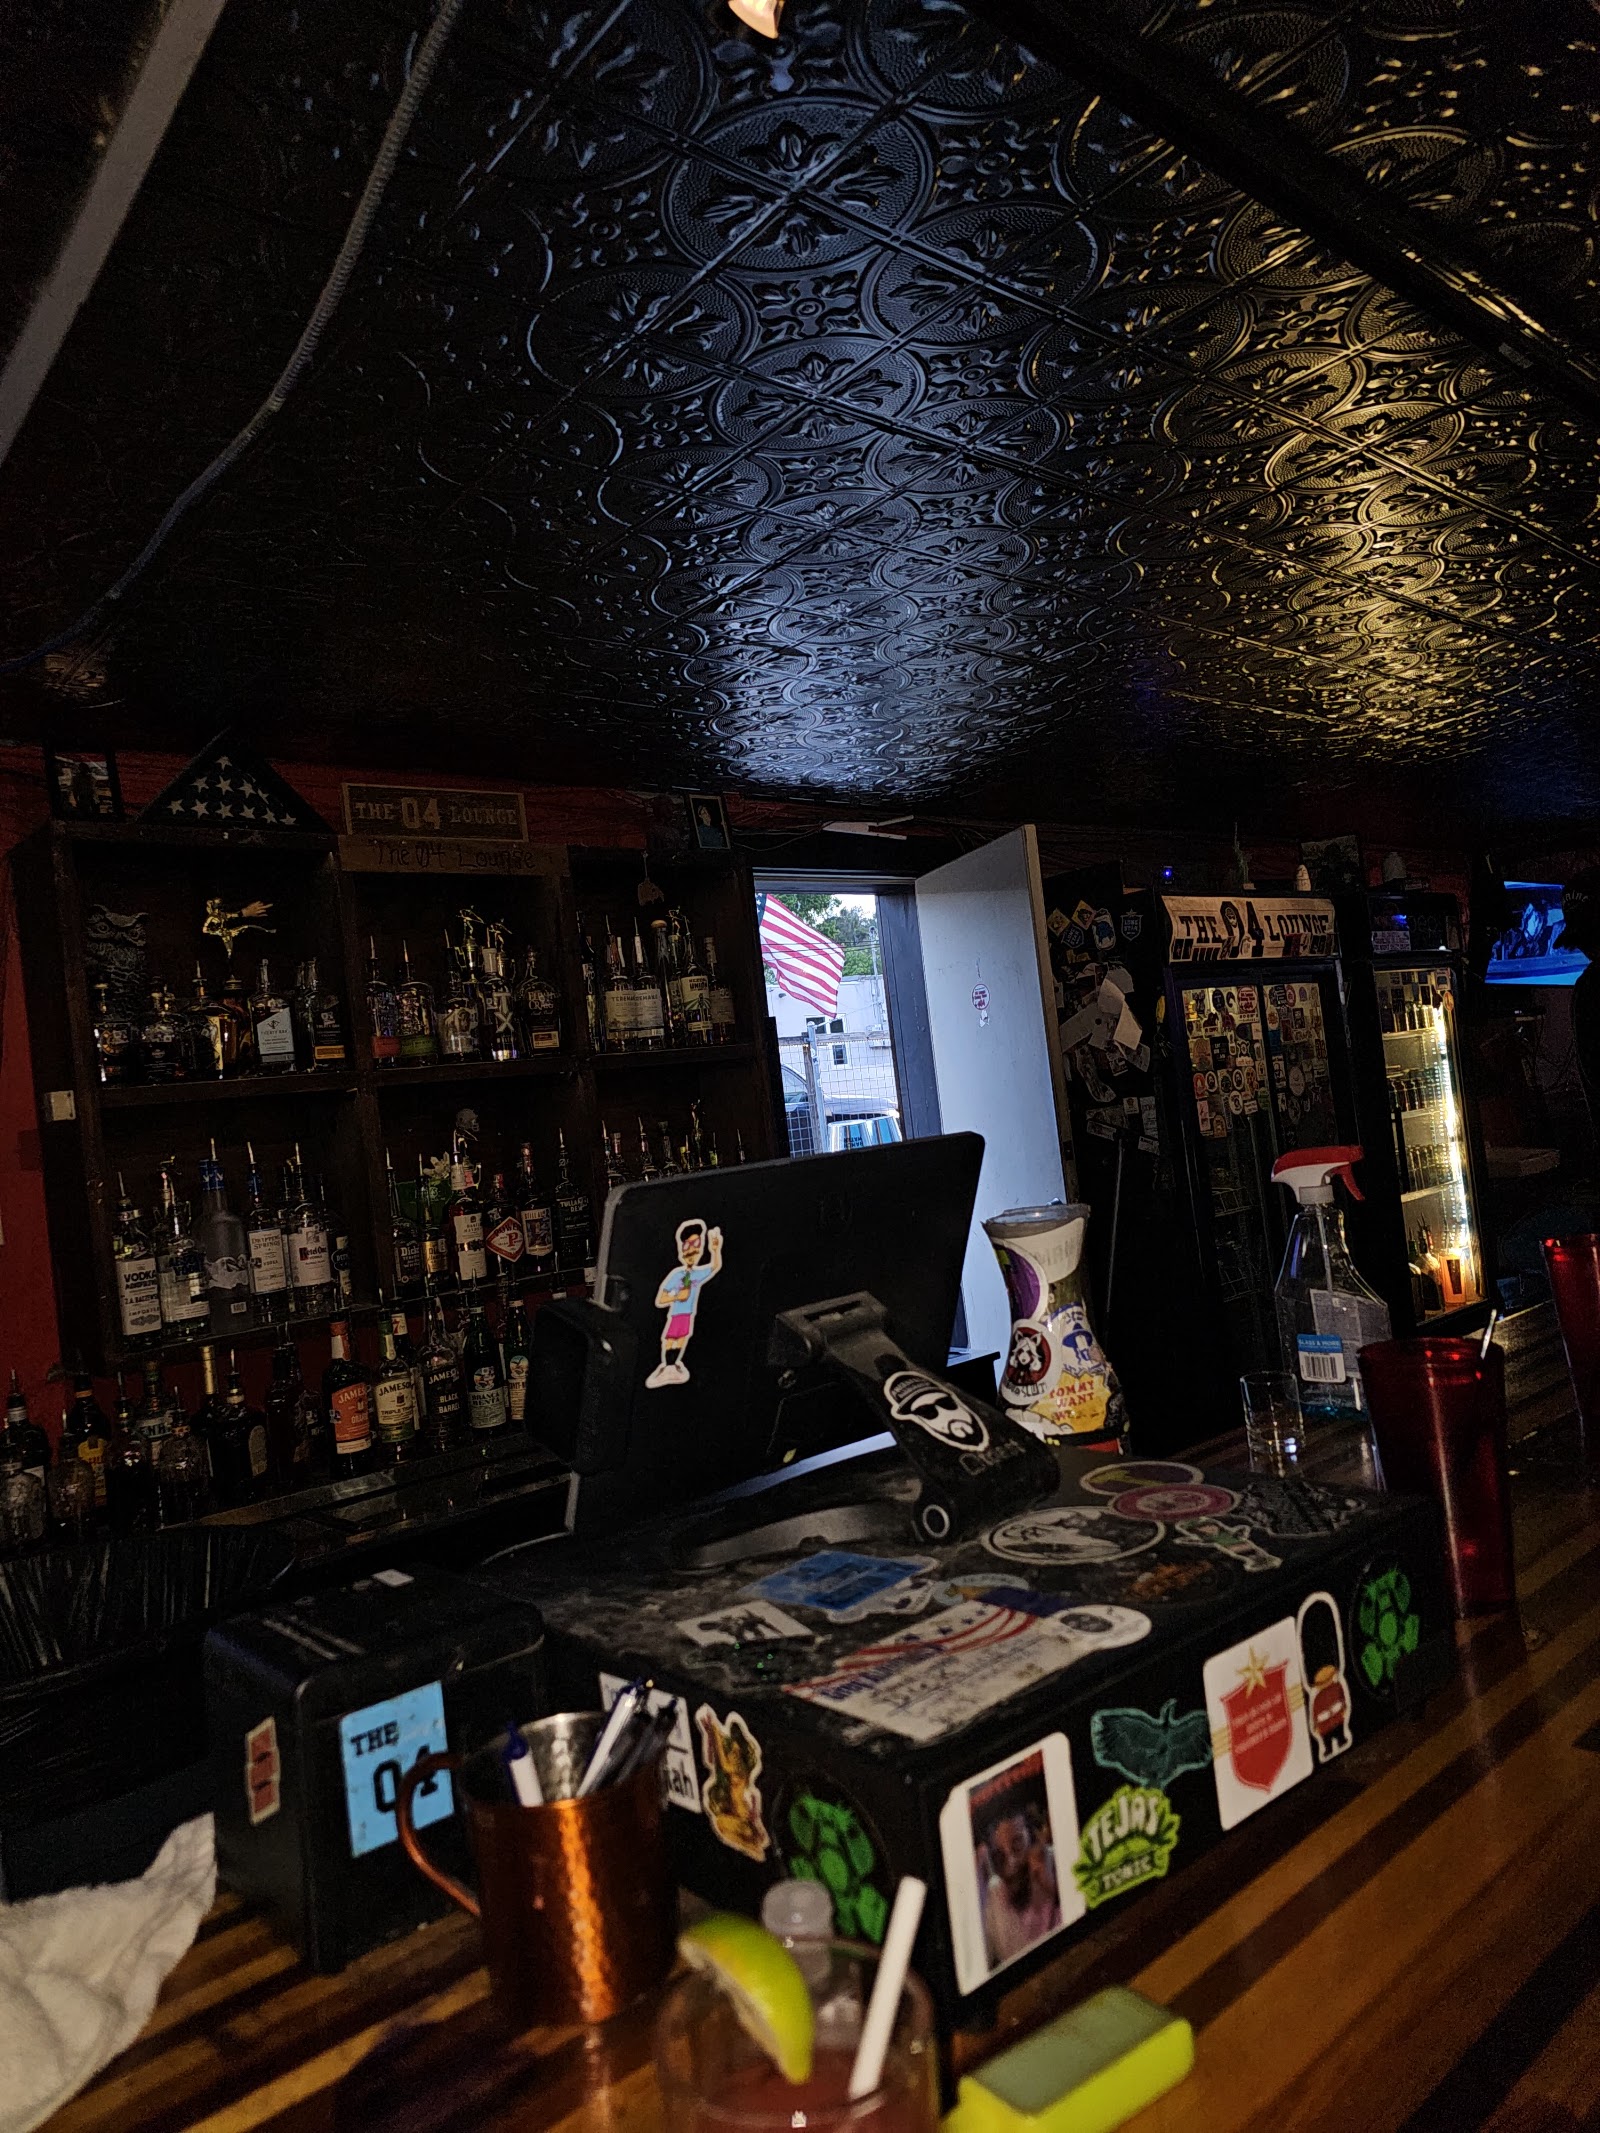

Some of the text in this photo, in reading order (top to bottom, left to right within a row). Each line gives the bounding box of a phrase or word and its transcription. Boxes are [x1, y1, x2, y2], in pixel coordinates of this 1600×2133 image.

[355, 797, 518, 829] THE 04 LOUNGE
[368, 838, 410, 866] The
[458, 844, 536, 869] Lounge
[1178, 916, 1226, 944] THE
[1264, 914, 1329, 942] LOUNGE
[299, 1247, 318, 1261] Ketel
[124, 1270, 157, 1282] VODKA
[1049, 1380, 1095, 1398] TOMMY
[439, 1393, 459, 1404] BLACK
[1056, 1391, 1095, 1408] WANT
[438, 1404, 461, 1414] BARREL
[350, 1721, 400, 1756] THE
[1088, 1795, 1160, 1862] TEJAS
